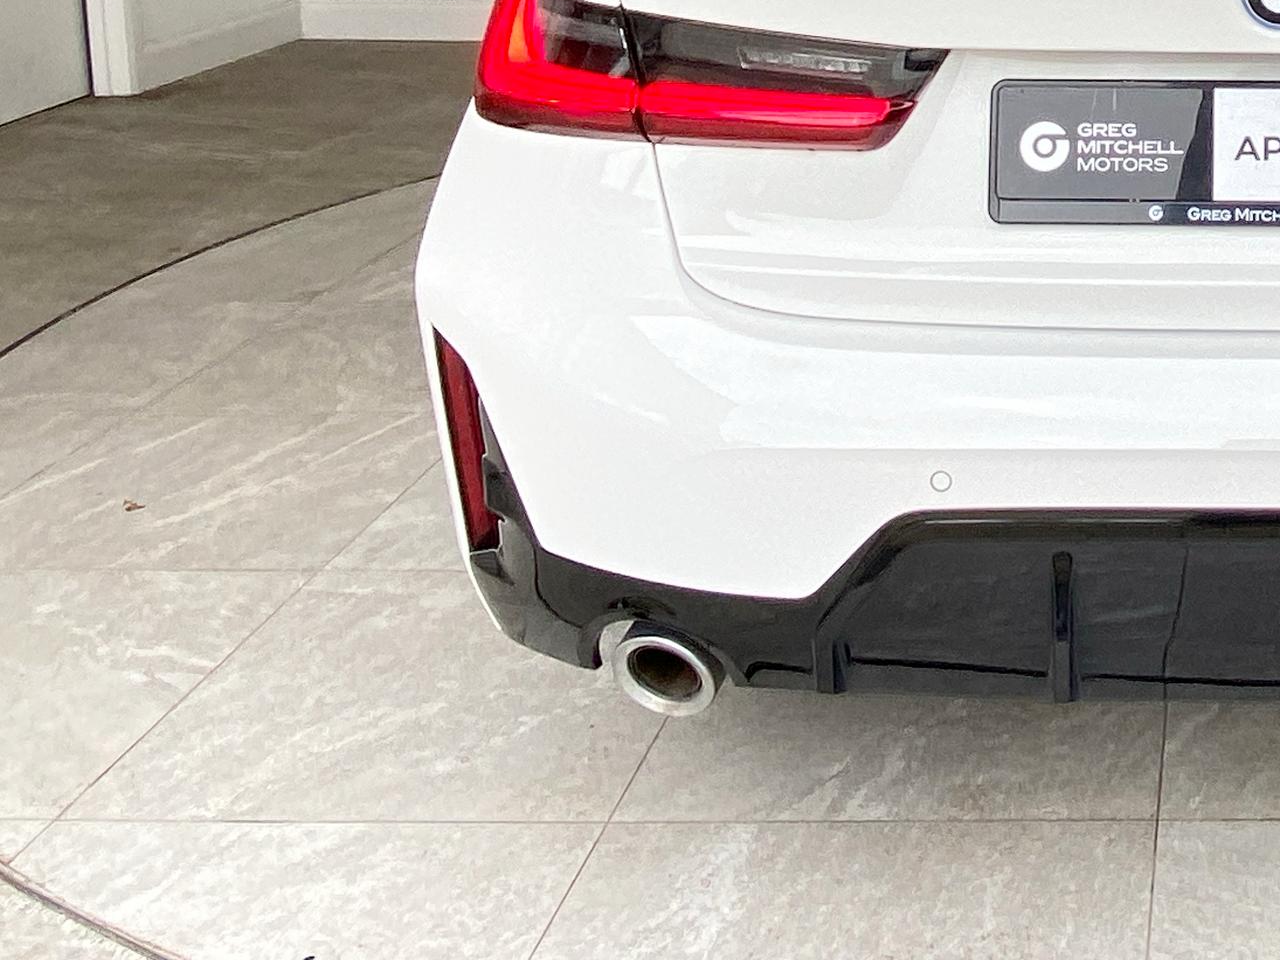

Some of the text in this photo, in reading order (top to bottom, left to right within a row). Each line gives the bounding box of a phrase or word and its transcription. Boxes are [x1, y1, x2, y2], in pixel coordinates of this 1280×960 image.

[1077, 122, 1137, 138] GREG
[1077, 140, 1184, 155] MITCHELL
[1077, 157, 1168, 172] MOTORS
